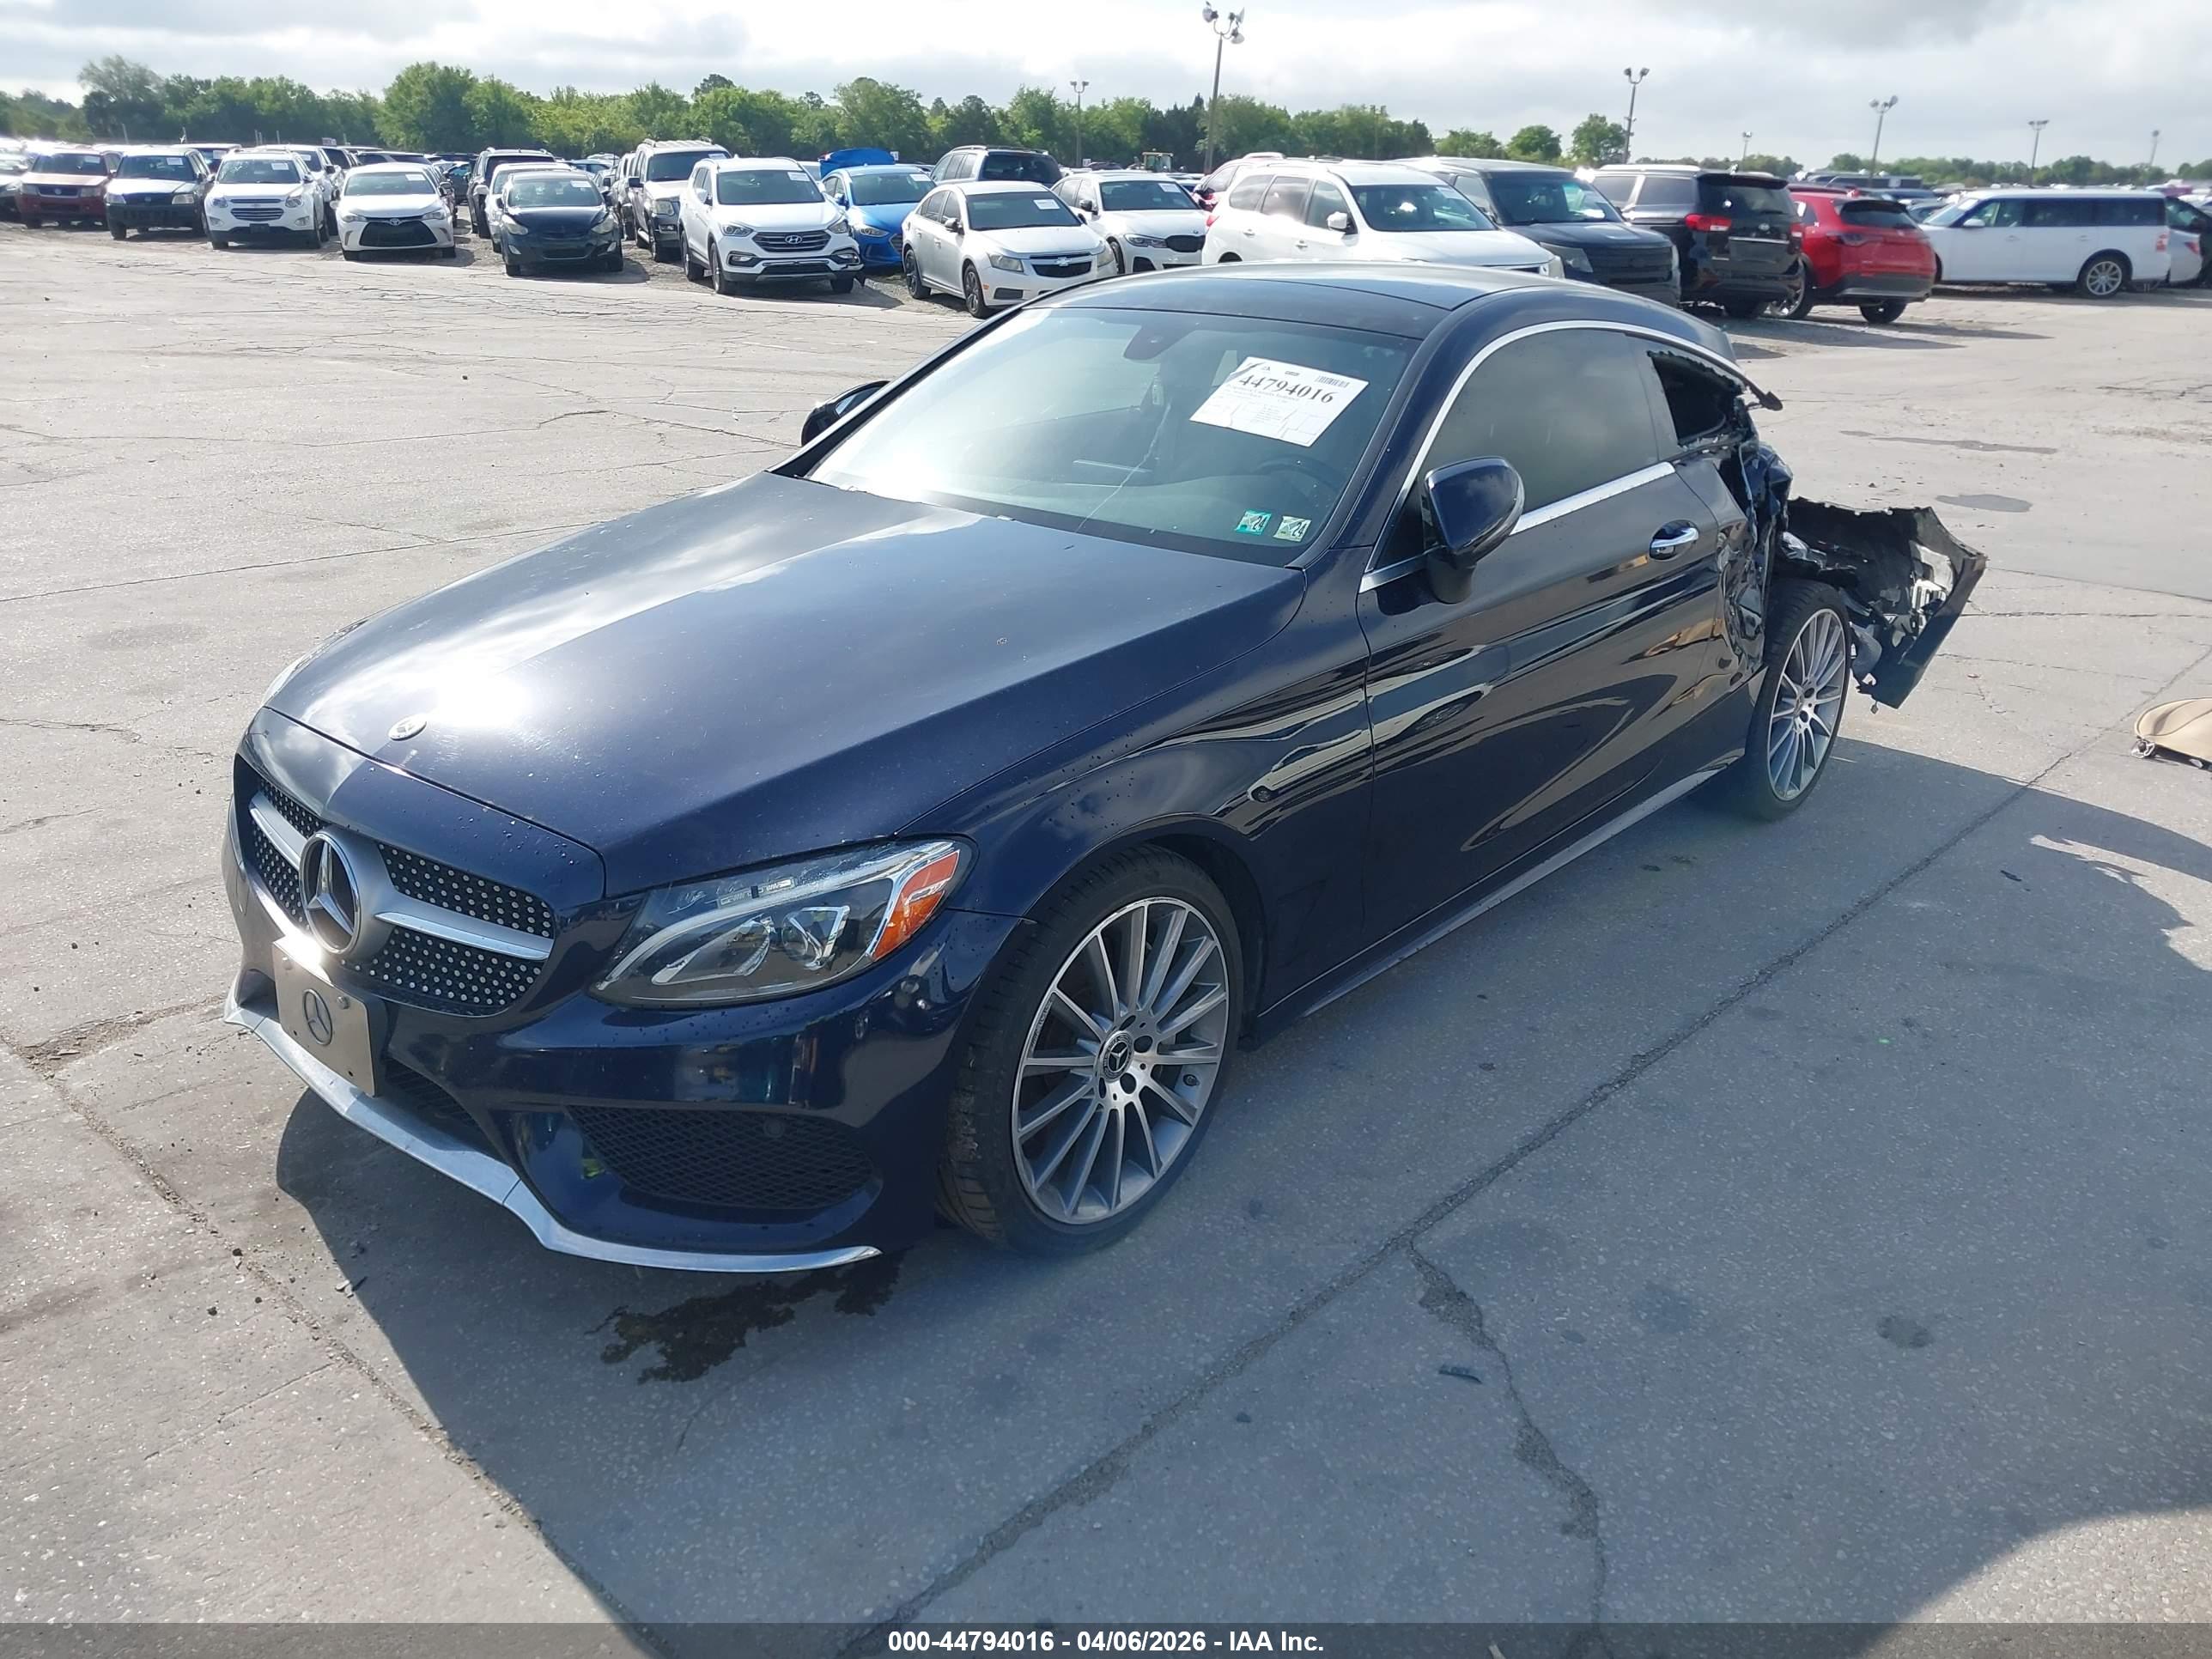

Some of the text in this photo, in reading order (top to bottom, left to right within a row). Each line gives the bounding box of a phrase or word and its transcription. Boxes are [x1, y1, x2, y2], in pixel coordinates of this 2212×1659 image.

[1239, 374, 1339, 404] 44794016
[1252, 515, 1268, 531] 24
[1291, 521, 1308, 538] 24
